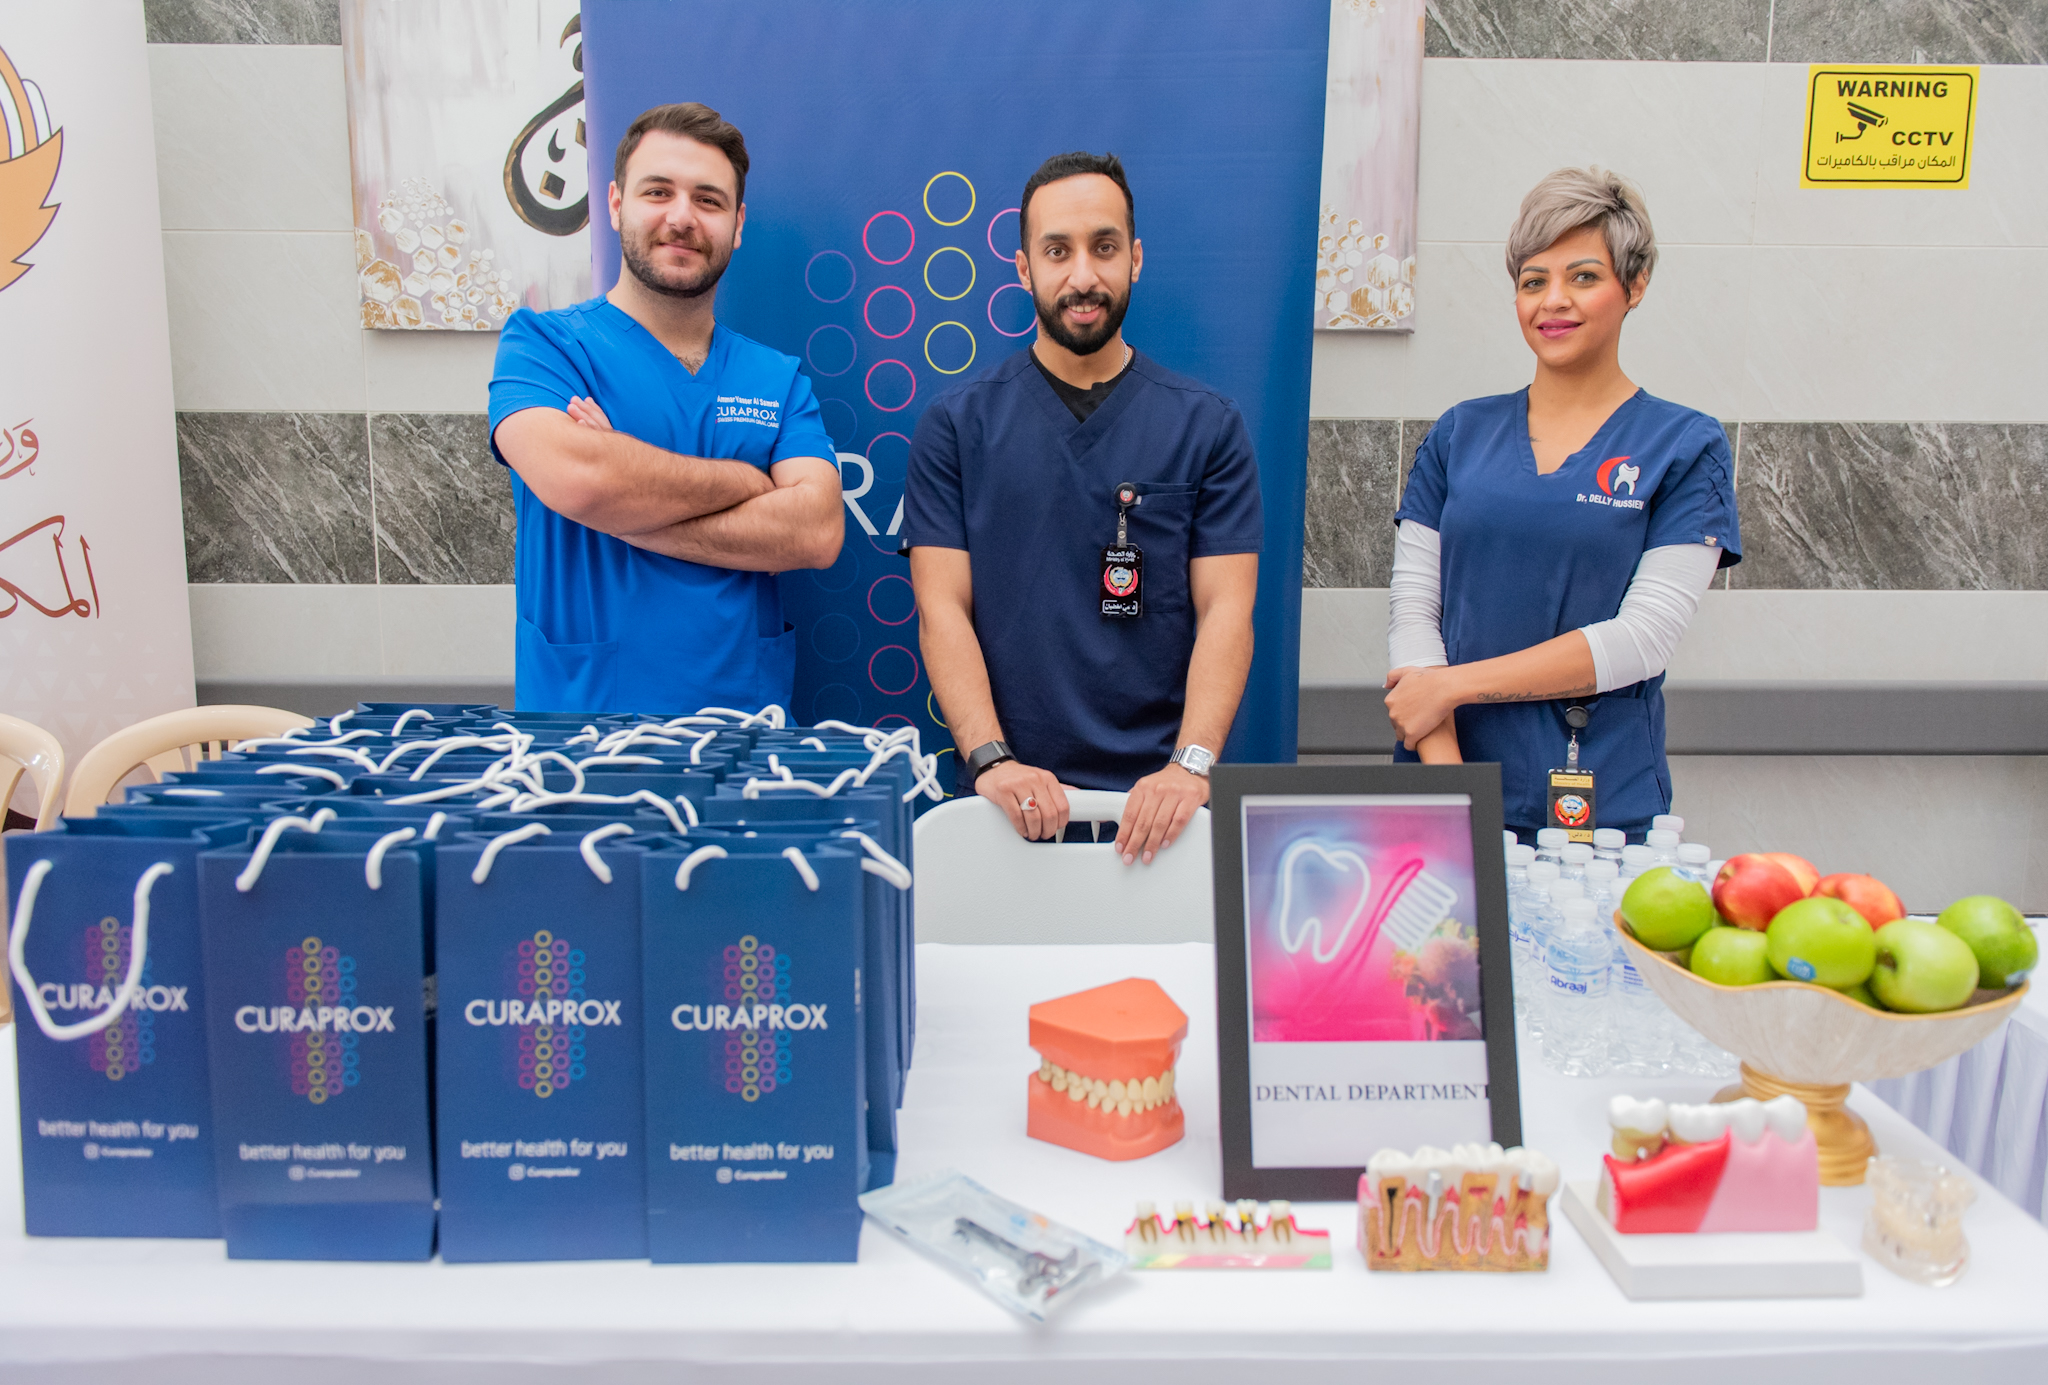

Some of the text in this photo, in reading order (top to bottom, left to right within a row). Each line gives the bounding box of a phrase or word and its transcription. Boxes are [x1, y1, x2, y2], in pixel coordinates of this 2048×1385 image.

[1837, 80, 1948, 98] WARNING
[1891, 131, 1954, 146] CCTV
[1817, 154, 1956, 170] المكان مراقب بالكاميرات
[1588, 494, 1613, 506] DELLY
[1550, 975, 1588, 994] Abraaj
[235, 1005, 396, 1033] CURAPROX
[465, 999, 622, 1027] CURAPROX
[671, 1003, 829, 1031] CURAPROX
[1256, 1084, 1490, 1101] DENTAL DEPARTMENT
[38, 1119, 199, 1142] better health for you
[239, 1142, 407, 1164] better health for you
[461, 1138, 628, 1160] better health for you
[669, 1141, 834, 1163] better health for you
